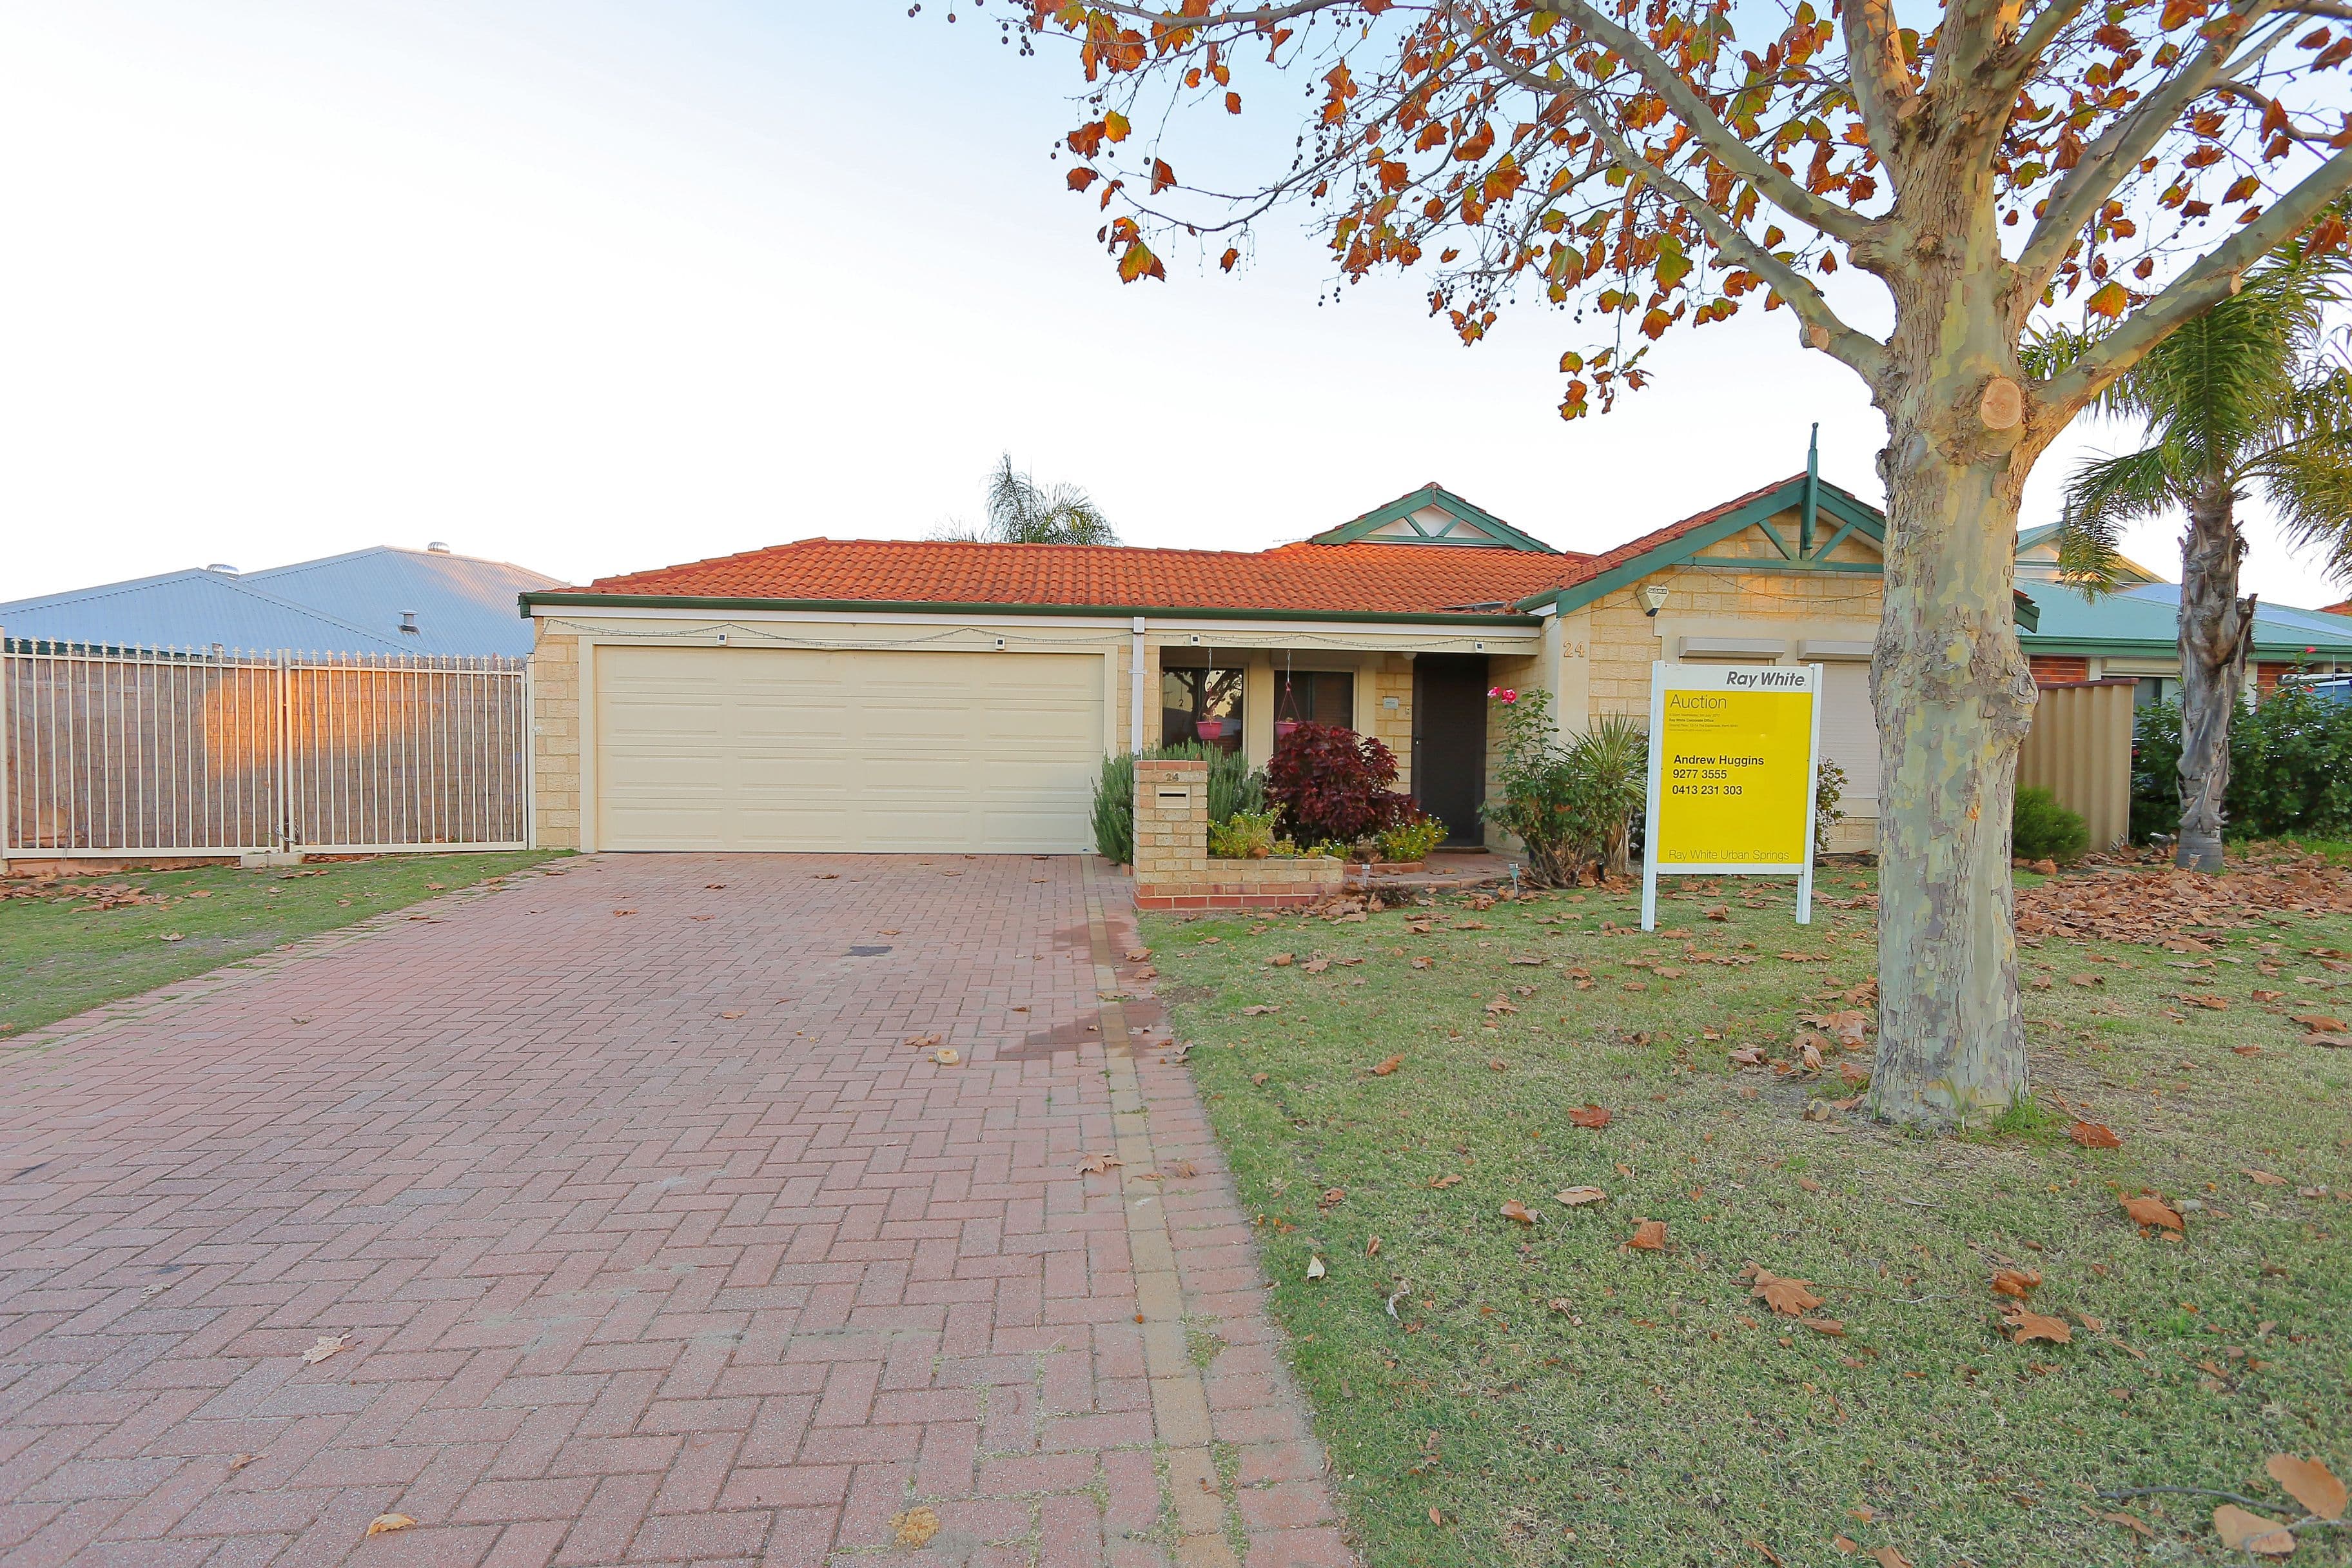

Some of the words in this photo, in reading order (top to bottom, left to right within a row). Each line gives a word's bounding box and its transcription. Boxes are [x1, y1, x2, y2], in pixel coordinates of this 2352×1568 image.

[1563, 641, 1585, 658] 24
[1727, 671, 1758, 688] Ray
[1761, 672, 1805, 686] White
[1670, 694, 1727, 709] Auction
[1674, 755, 1716, 764] Andrew
[1719, 756, 1764, 767] Huggins
[1166, 773, 1179, 781] 24
[1673, 769, 1698, 779] 9277
[1701, 770, 1727, 779] 3555
[1672, 785, 1698, 795] 0413
[1701, 785, 1719, 795] 231
[1723, 786, 1743, 795] 303
[1669, 849, 1688, 861] Ray
[1690, 850, 1718, 859] White
[1721, 850, 1750, 859] Urban
[1753, 850, 1789, 861] Springs
